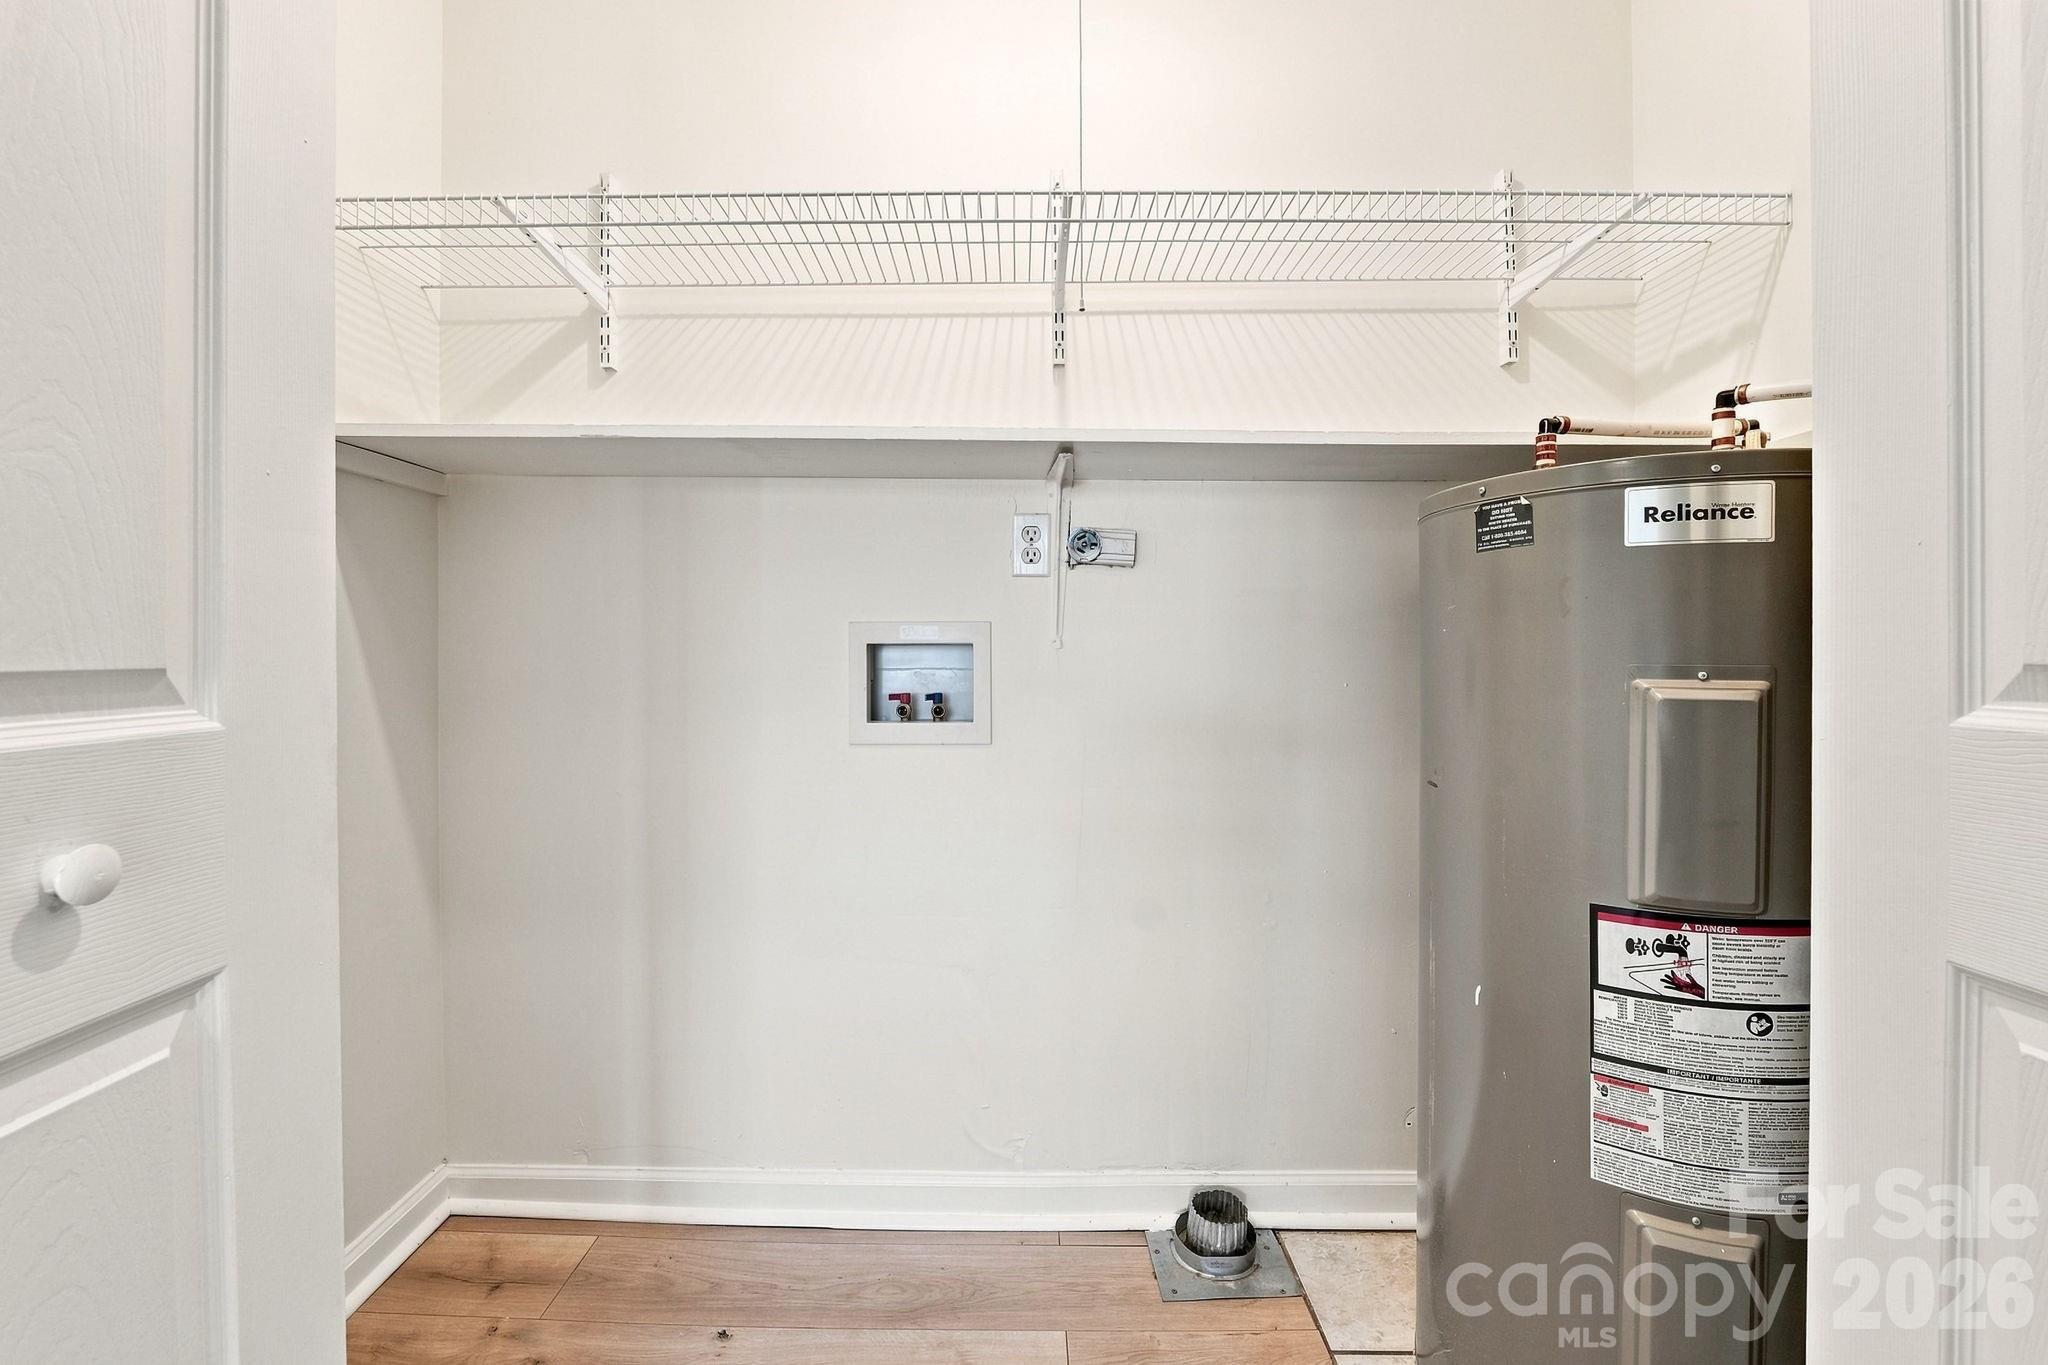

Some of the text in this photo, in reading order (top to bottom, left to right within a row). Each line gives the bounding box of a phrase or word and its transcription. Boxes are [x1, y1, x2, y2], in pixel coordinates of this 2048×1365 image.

[1644, 503, 1755, 523] Reliance
[1694, 924, 1738, 934] DANGER
[1667, 1068, 1710, 1080] IMPORTANT
